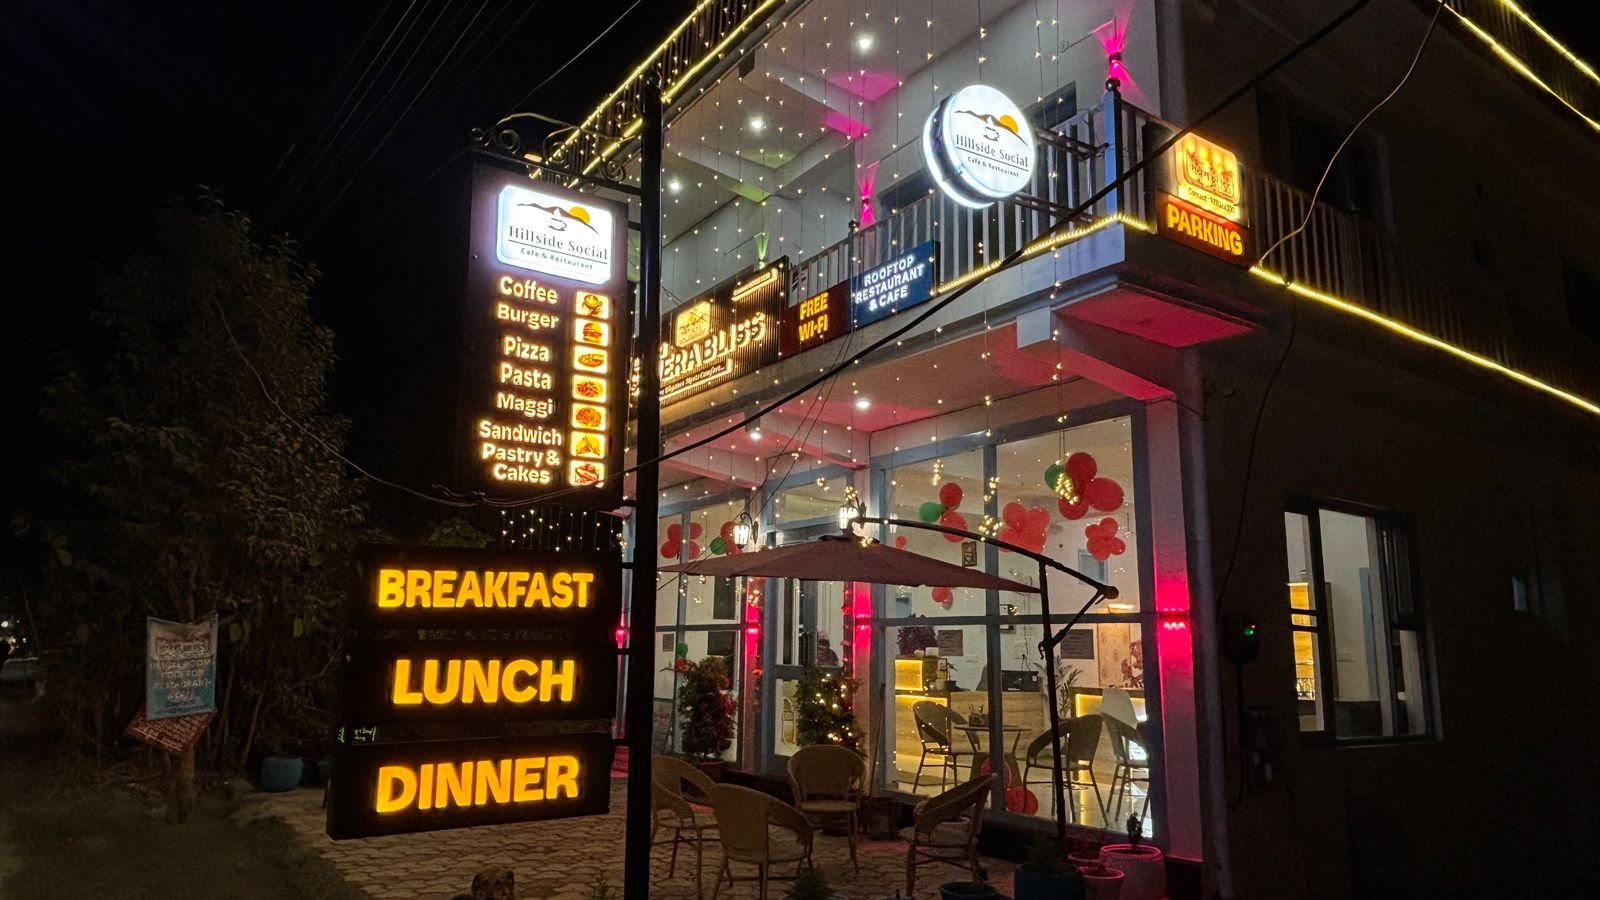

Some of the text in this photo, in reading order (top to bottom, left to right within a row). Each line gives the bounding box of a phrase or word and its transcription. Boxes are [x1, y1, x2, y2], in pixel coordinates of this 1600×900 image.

[956, 134, 1029, 168] Hillside Social
[967, 156, 981, 166] Cafe
[988, 162, 1019, 177] Restaurant
[508, 225, 608, 260] Hillside Social
[1167, 203, 1243, 256] PARKING
[520, 247, 539, 257] Cafe
[550, 254, 593, 271] Restaurant
[863, 254, 915, 287] ROOFTOP
[499, 275, 559, 305] Coffee
[855, 263, 925, 304] RESTAURANT
[800, 292, 829, 321] FREE
[868, 284, 909, 312] & CAFE
[496, 302, 560, 330] Burger
[798, 314, 829, 342] WI-FI
[503, 335, 551, 363] Pizza
[500, 362, 552, 390] Pasta
[496, 391, 554, 419] Maggi
[478, 419, 563, 447] Sandwich
[481, 442, 561, 468] Pastry &
[492, 462, 551, 485] Cakes
[377, 568, 595, 609] BREAKFAST
[392, 658, 576, 705] LUNCH
[375, 754, 580, 813] DINNER
